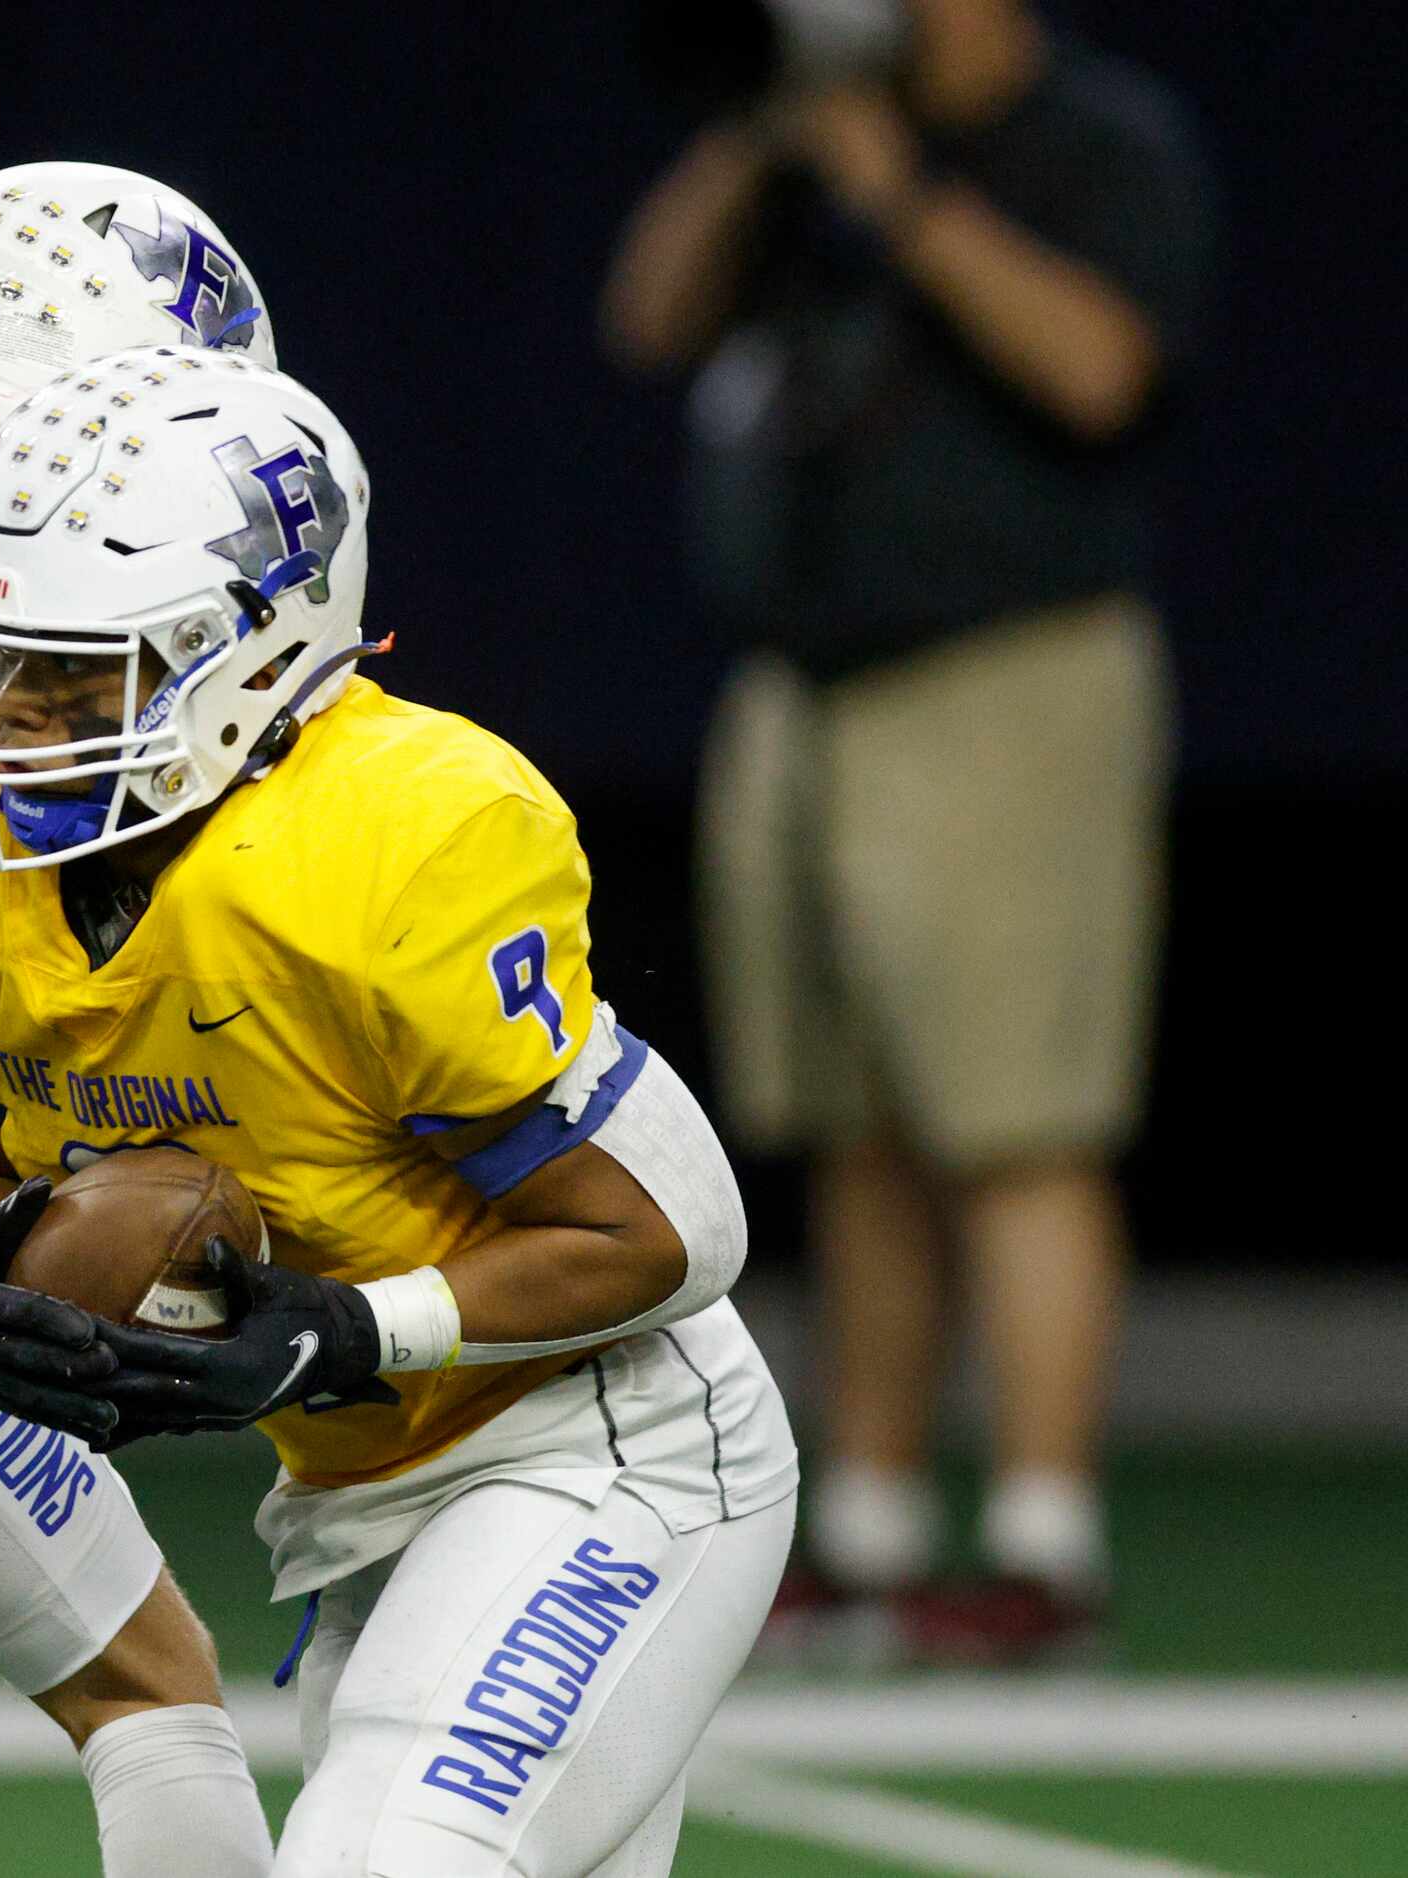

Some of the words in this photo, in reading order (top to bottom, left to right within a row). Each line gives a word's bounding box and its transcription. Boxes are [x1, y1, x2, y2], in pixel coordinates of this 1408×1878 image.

[154, 223, 241, 342] F
[248, 443, 324, 598] F
[486, 924, 573, 1059] 9
[66, 1070, 239, 1128] ORIGINAL
[420, 1538, 660, 1816] RACCOONS
